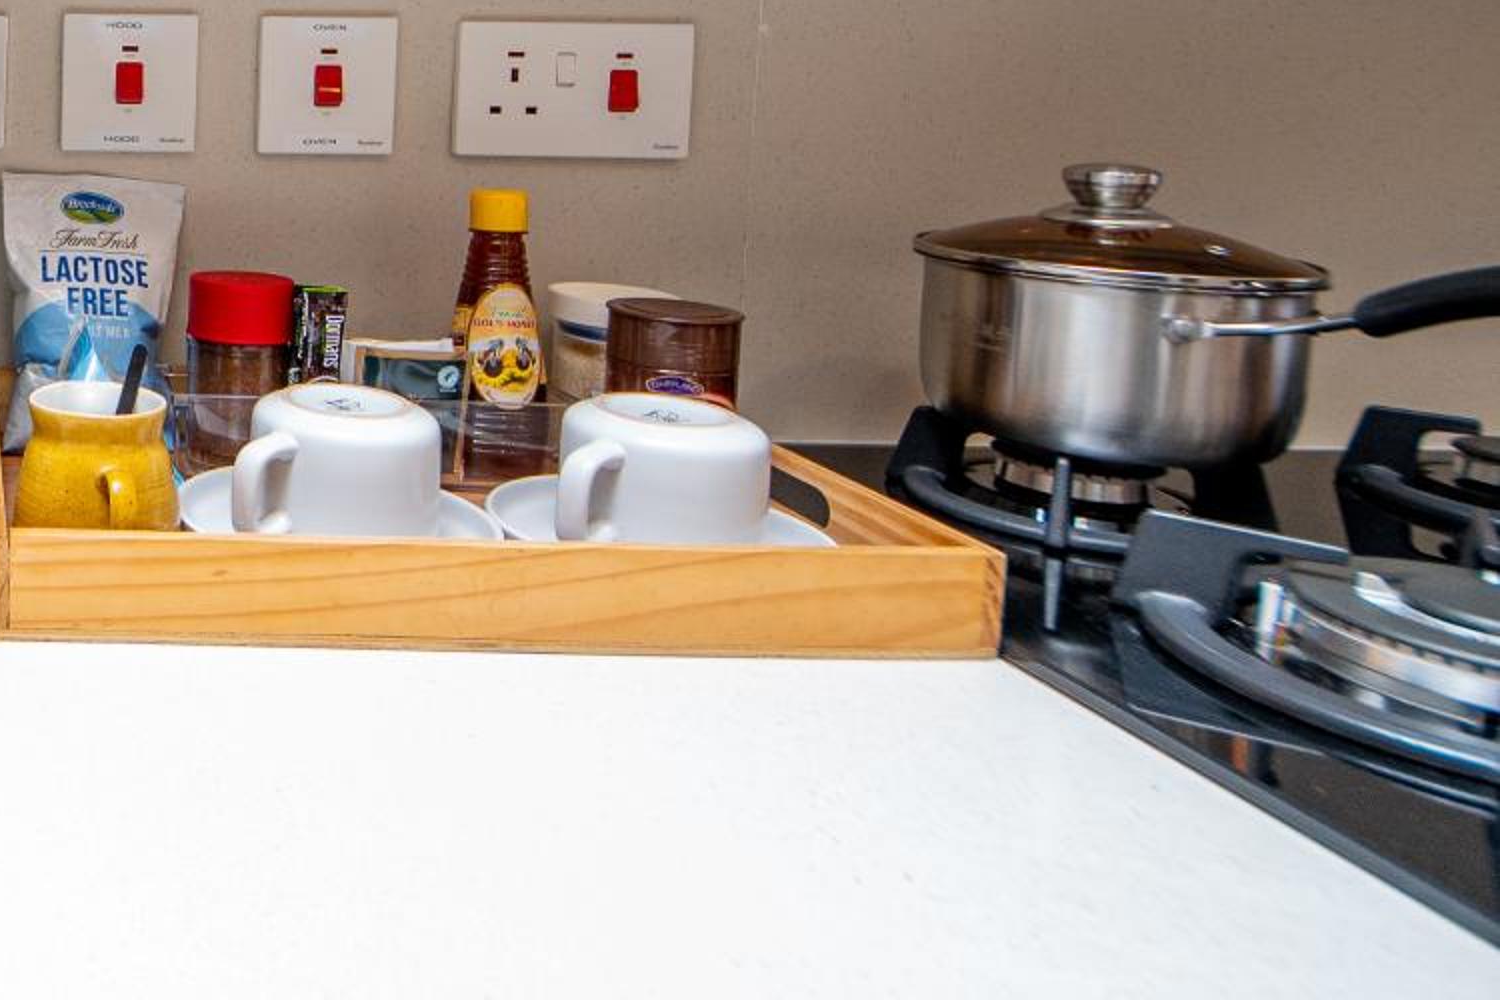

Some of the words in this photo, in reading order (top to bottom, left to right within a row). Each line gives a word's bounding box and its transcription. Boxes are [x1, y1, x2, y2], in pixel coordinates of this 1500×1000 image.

[50, 228, 98, 250] Farm
[98, 230, 141, 250] Fresh
[40, 255, 149, 289] LACTOSE
[67, 286, 130, 318] FREE
